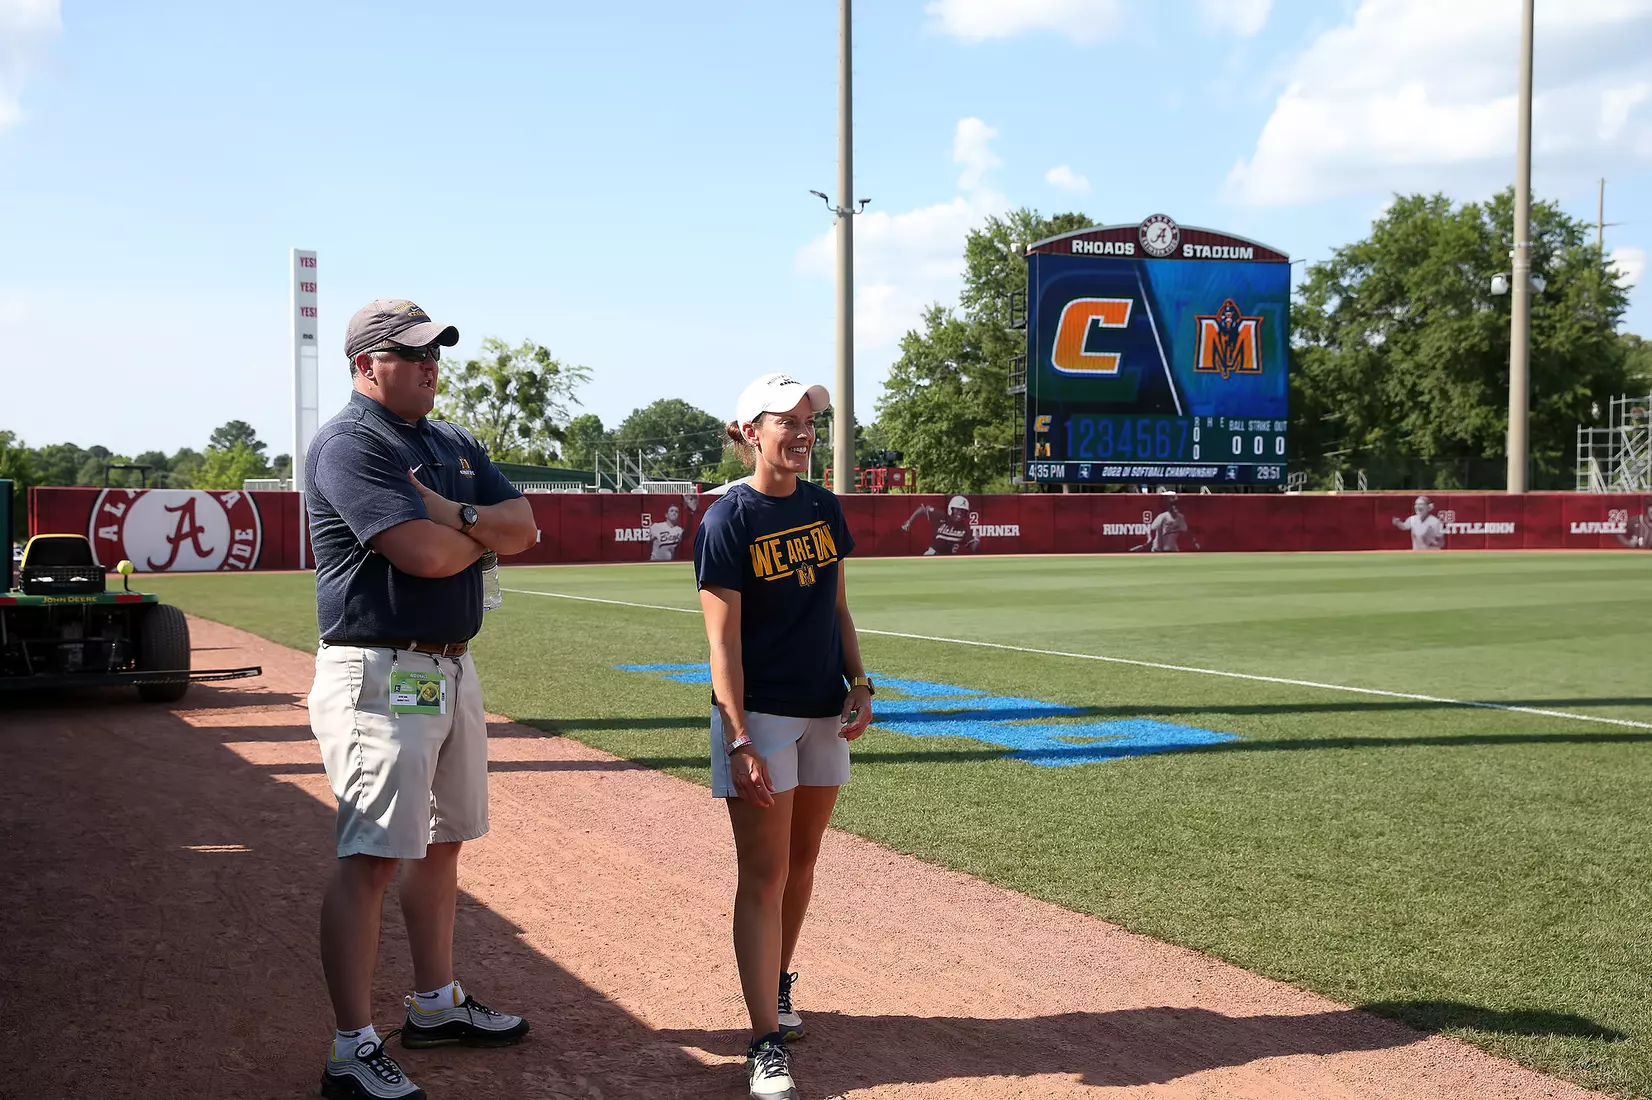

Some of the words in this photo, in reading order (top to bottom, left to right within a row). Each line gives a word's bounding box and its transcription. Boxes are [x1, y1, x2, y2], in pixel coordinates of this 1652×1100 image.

[1072, 240, 1134, 255] RHOADS
[1183, 244, 1253, 259] STADIUM
[300, 257, 317, 268] YES!
[300, 281, 317, 293] YES!
[300, 306, 317, 318] YES!
[1051, 297, 1134, 376] C
[1194, 312, 1264, 377] M
[1229, 420, 1245, 431] BALL
[1248, 420, 1271, 431] STRIKE
[1274, 421, 1288, 432] OUT
[1193, 427, 1200, 442] 0
[1193, 444, 1200, 460] 0
[1232, 436, 1242, 454] 0
[1254, 436, 1263, 454] 0
[1275, 436, 1285, 455] 0
[1050, 464, 1065, 478] PM
[1131, 466, 1163, 477] SOFTBALL
[1165, 467, 1218, 478] CHAMPIONSHIP
[641, 513, 651, 527] 5
[969, 512, 978, 525] 2
[1143, 511, 1152, 524] 9
[147, 497, 214, 570] A
[615, 528, 650, 541] DARE
[970, 525, 1020, 537] TURNER
[1103, 523, 1150, 535] RUNYON
[749, 538, 789, 578] WE
[786, 535, 815, 563] ARE
